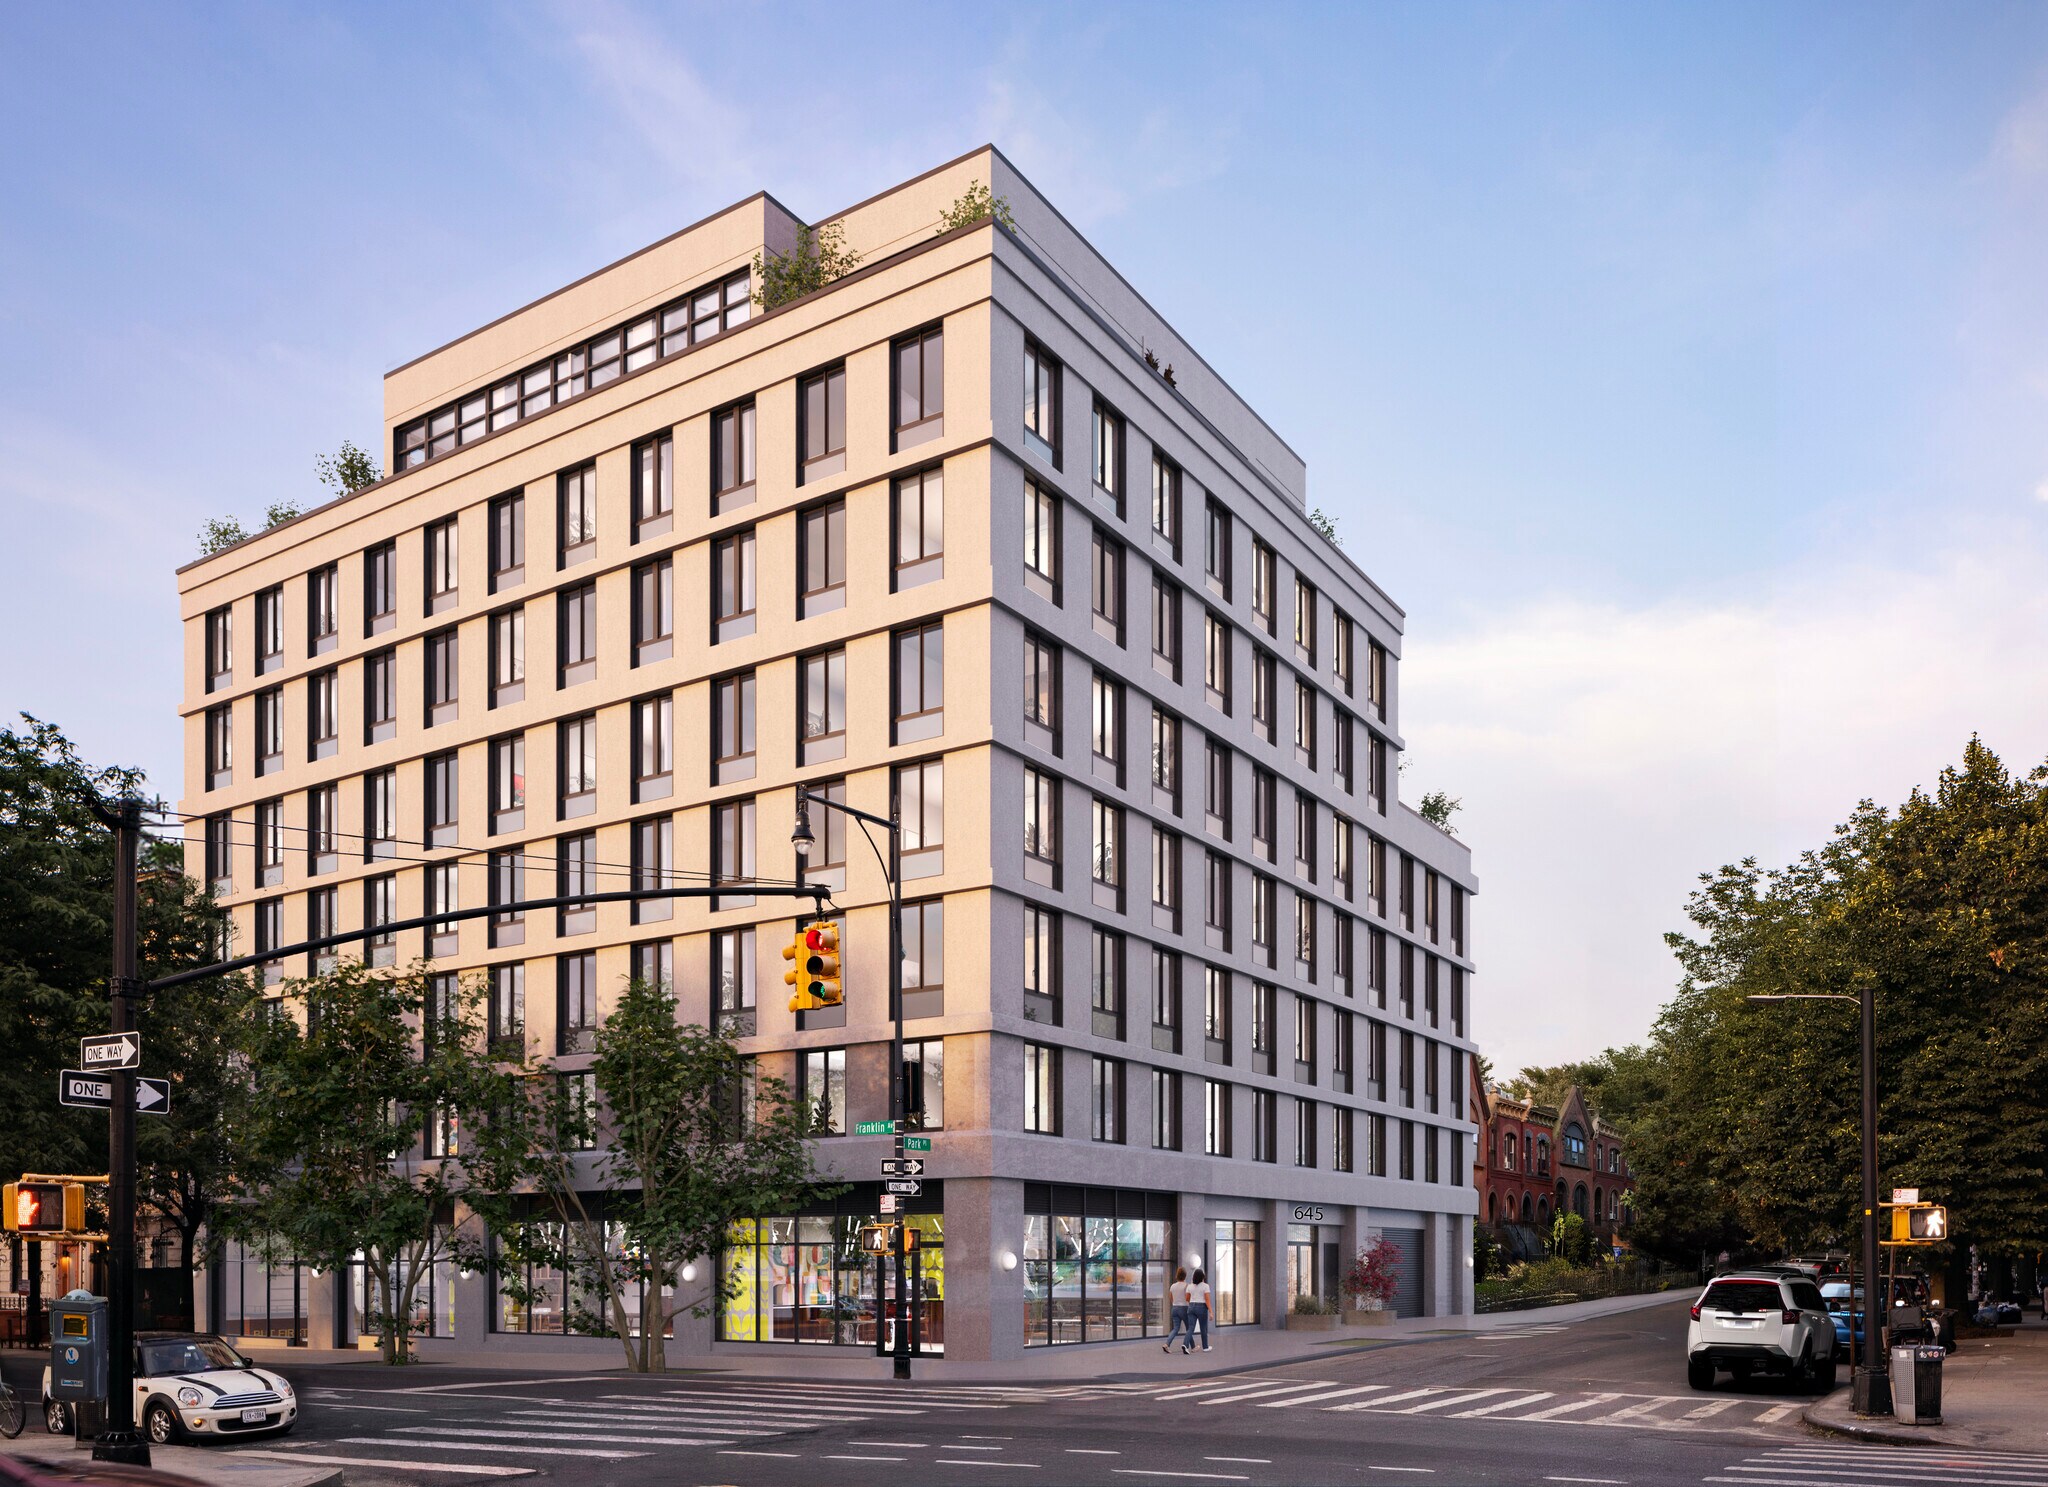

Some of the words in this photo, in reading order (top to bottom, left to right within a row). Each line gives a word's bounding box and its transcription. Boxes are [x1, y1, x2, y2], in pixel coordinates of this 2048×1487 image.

[87, 1047, 103, 1060] ONE
[107, 1045, 123, 1058] WAY
[74, 1082, 103, 1097] ONE
[855, 1122, 885, 1134] Franklin
[907, 1138, 921, 1149] Park
[891, 1183, 902, 1191] ONE
[1294, 1205, 1323, 1221] 645
